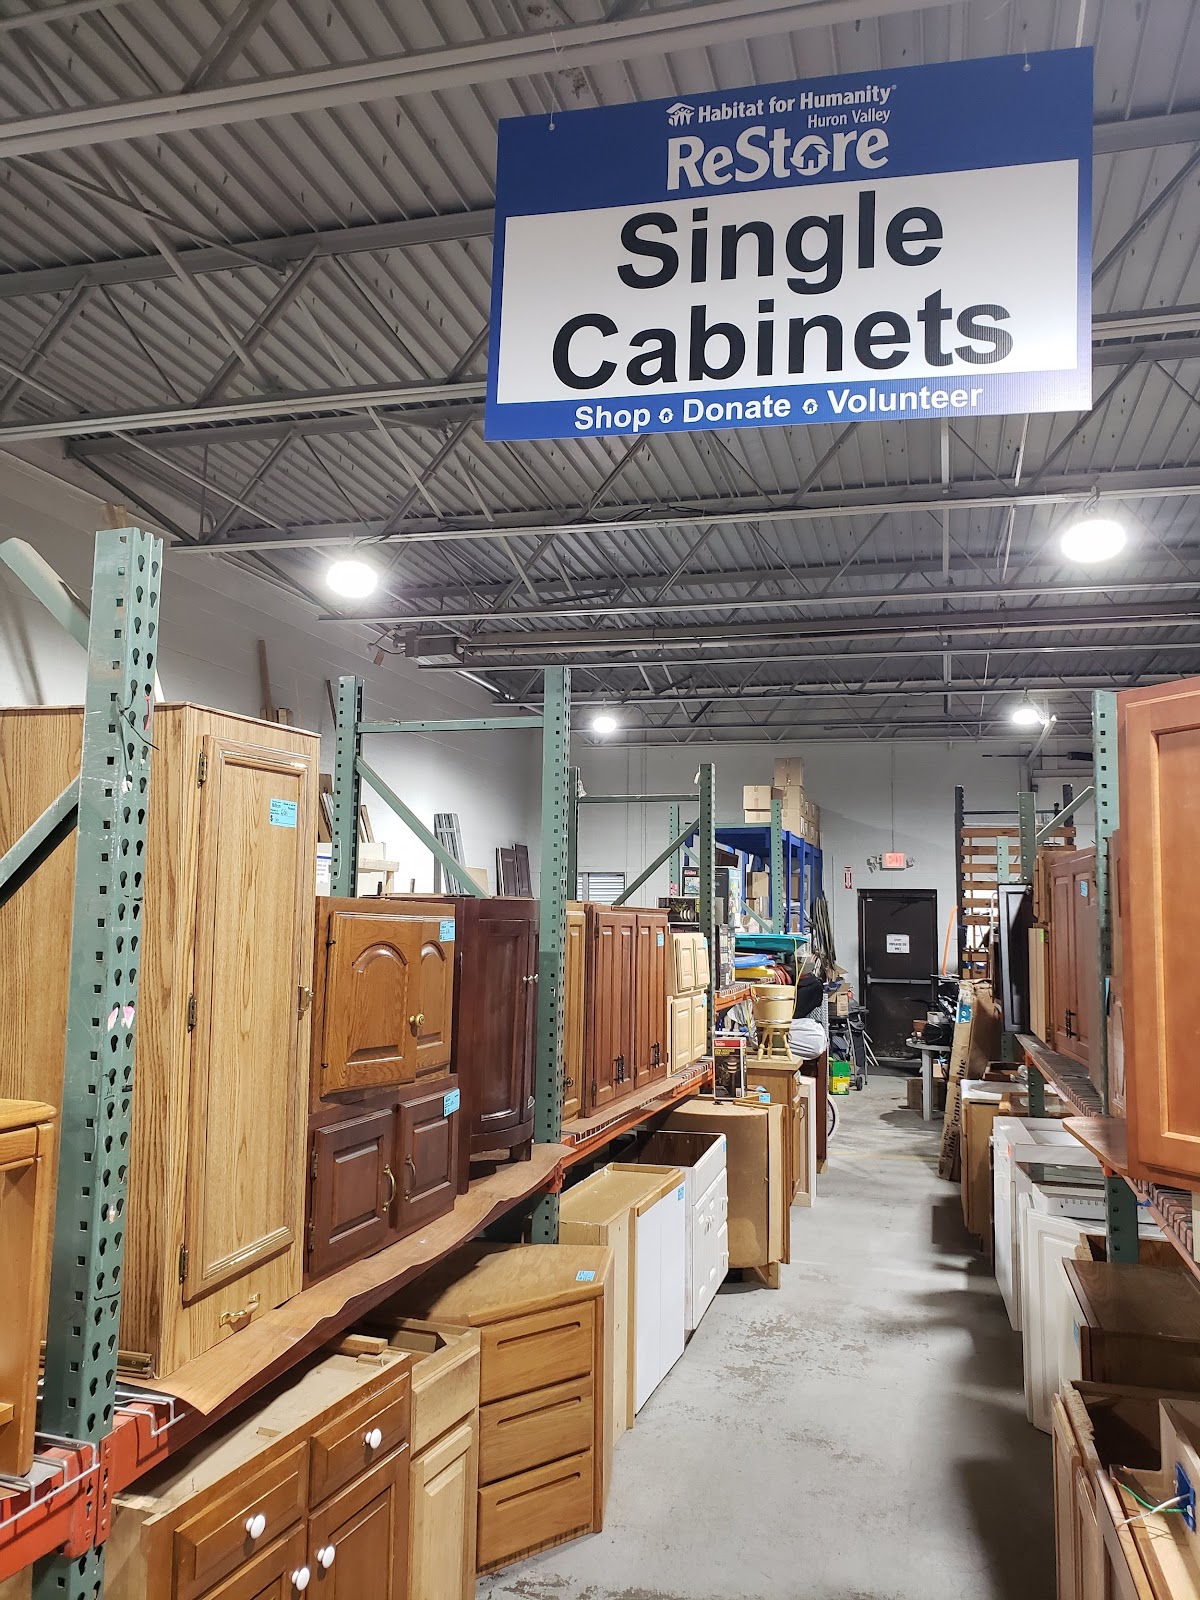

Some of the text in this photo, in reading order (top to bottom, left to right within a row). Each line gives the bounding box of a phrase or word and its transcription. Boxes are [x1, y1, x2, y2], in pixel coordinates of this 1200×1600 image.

[698, 85, 892, 123] Habitat for Humanity
[808, 107, 891, 129] Huron Valley
[666, 125, 889, 191] ReStore
[617, 190, 944, 295] Single
[551, 288, 1014, 390] Cabinets
[574, 384, 984, 432] Shop Donate Volunteer
